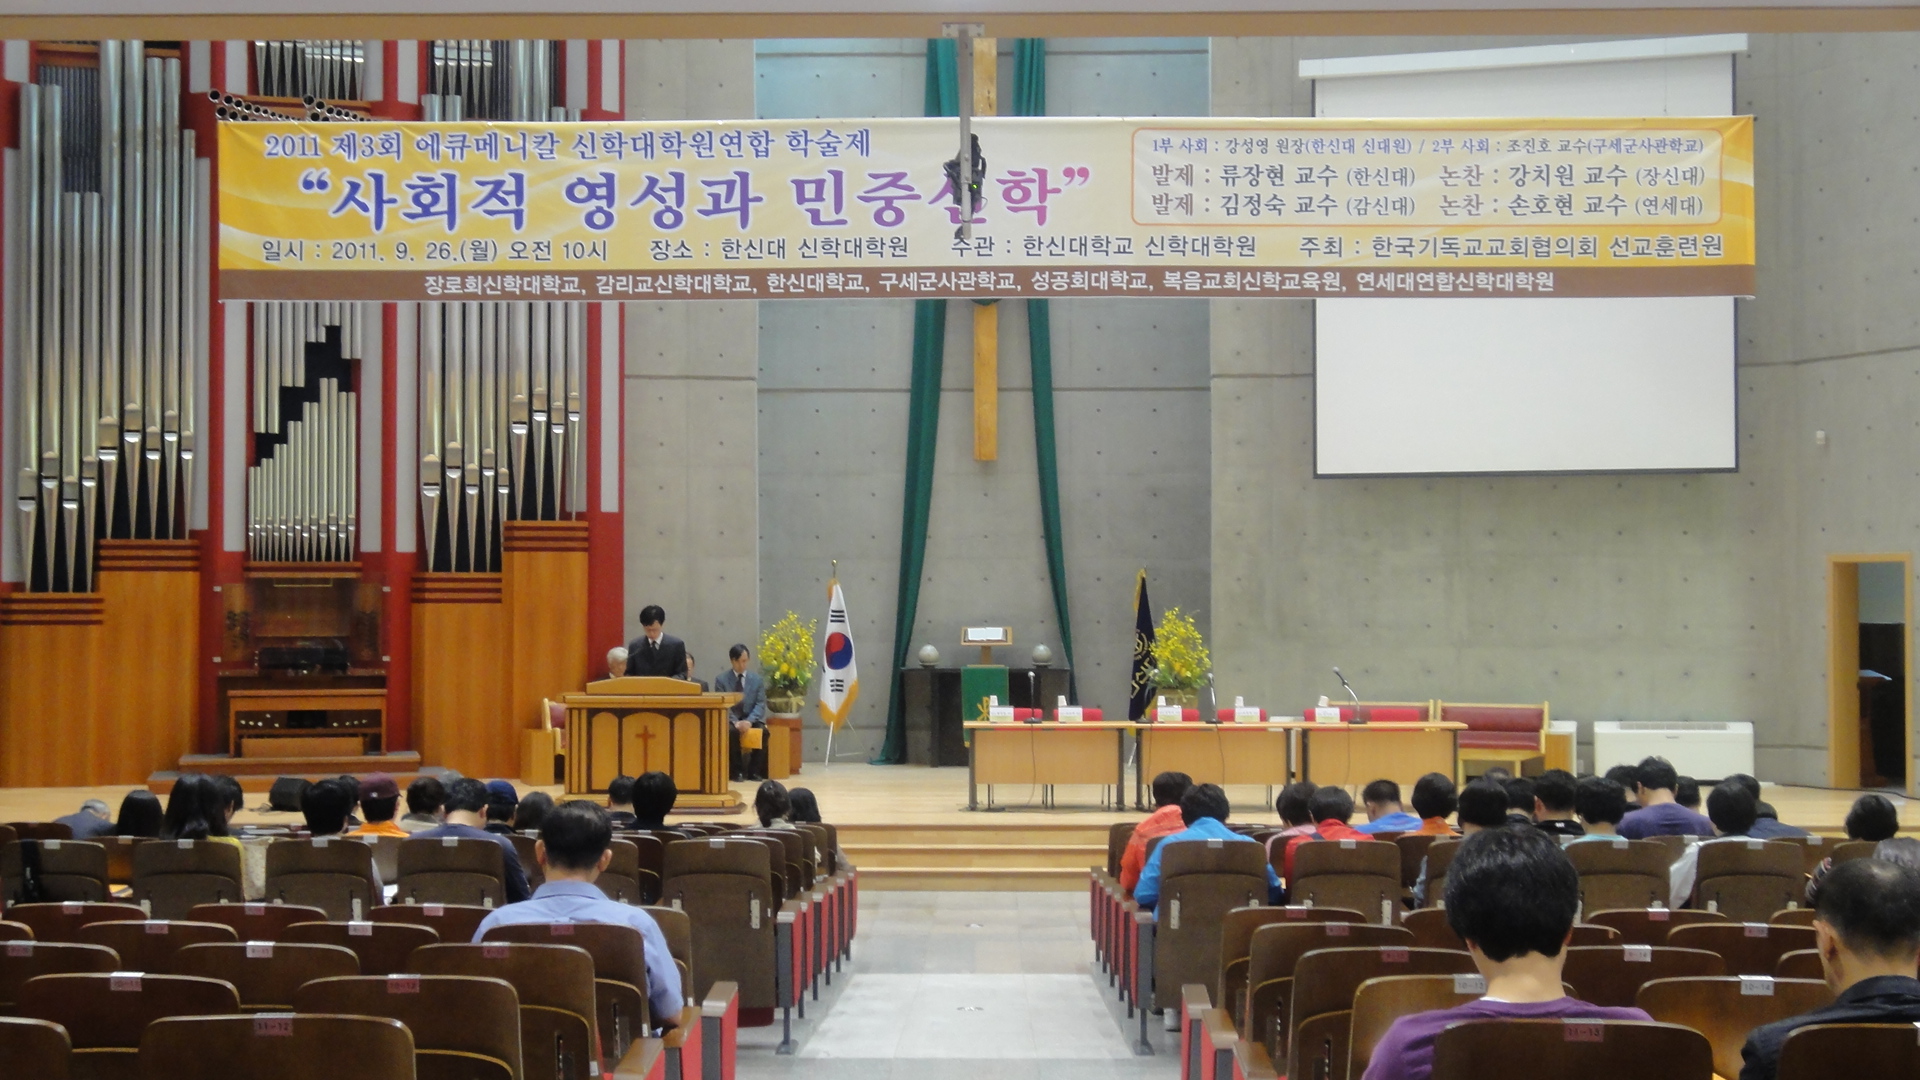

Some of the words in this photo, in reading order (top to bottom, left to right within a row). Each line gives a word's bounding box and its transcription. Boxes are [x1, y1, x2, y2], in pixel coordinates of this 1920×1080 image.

[265, 132, 322, 157] 2011
[334, 132, 400, 160] 제3회
[416, 130, 560, 160] 에큐메니칼
[573, 130, 775, 160] 신학대학원연합
[786, 129, 869, 158] 학술제
[1153, 138, 1173, 153] 1부
[1179, 138, 1207, 154] 사회
[1226, 138, 1268, 154] 강성영
[1276, 138, 1354, 154] 원장(한신대
[1363, 138, 1411, 154] 신대원)
[1433, 138, 1454, 154] 2부
[1461, 138, 1489, 154] 사회
[1507, 138, 1551, 154] 조진호
[1558, 138, 1703, 154] 교수(구세군사관학교)
[1152, 164, 1193, 187] 발제
[1220, 164, 1284, 187] 류장현
[1295, 165, 1338, 187] 교수
[1347, 167, 1415, 187] (한신대)
[1440, 164, 1484, 187] 논찬
[1510, 164, 1574, 187] 강치원
[1584, 164, 1627, 187] 교수
[1636, 166, 1704, 186] (장신대)
[301, 170, 525, 232] “사회적
[566, 171, 763, 230] 영성과
[1152, 193, 1193, 216] 발제
[1221, 193, 1286, 216] 김정숙
[1294, 194, 1338, 216] 교수
[1347, 196, 1415, 216] (감신대)
[1439, 194, 1484, 216] 논찬
[1508, 193, 1573, 216] 손호현
[1583, 194, 1627, 216] 교수
[1635, 196, 1702, 215] (연세대)
[263, 241, 302, 261] 일시
[333, 242, 383, 261] 2011.
[396, 242, 414, 261] 9.
[509, 241, 550, 260] 오전
[563, 240, 606, 261] 10시
[651, 240, 692, 260] 장소
[722, 239, 785, 259] 한신대
[798, 237, 907, 258] 신학대학원
[951, 236, 995, 257] 주관
[1024, 236, 1133, 256] 한신대학교
[1145, 236, 1255, 257] 신학대학원
[1300, 237, 1342, 257] 주최
[1373, 237, 1596, 258] 한국기독교교회협의회
[1610, 236, 1721, 257] 선교훈련원
[425, 275, 586, 295] 장로회신학대학교,
[596, 274, 757, 294] 감리교신학대학교,
[767, 273, 869, 293] 한신대학교,
[879, 271, 1021, 291] 구세군사관학교,
[1031, 271, 1153, 291] 성공회대학교,
[1163, 271, 1346, 291] 복음교회신학교육원,
[1357, 272, 1553, 291] 연세대연합신학대학원
[258, 1022, 289, 1031] 11-12
